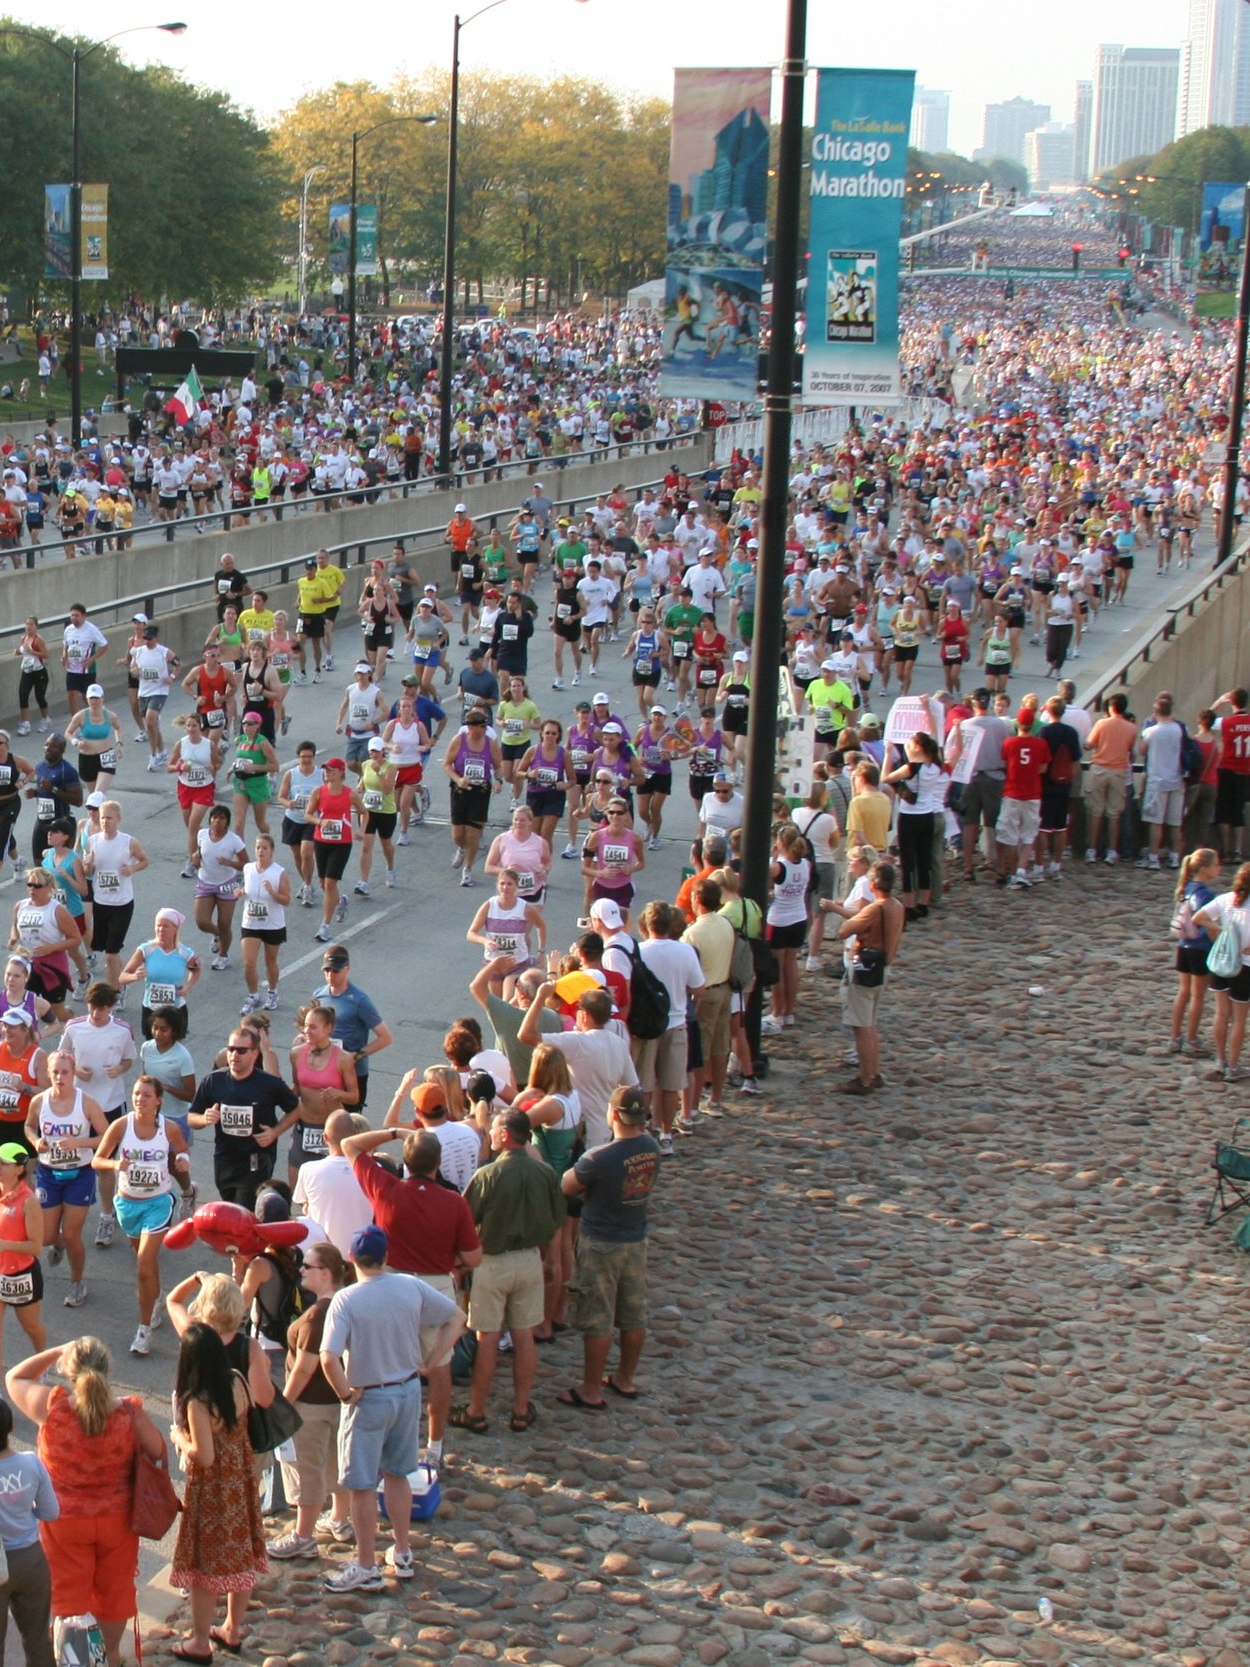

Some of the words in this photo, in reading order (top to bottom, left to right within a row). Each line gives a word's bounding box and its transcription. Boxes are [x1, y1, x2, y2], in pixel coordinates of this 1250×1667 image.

[811, 133, 891, 167] Chicago
[810, 169, 905, 198] Marathon
[810, 381, 852, 392] OCTOBER
[853, 383, 868, 394] 07,
[869, 383, 893, 393] 2007
[709, 410, 725, 421] TOP
[1233, 735, 1250, 758] 11
[1019, 747, 1031, 765] 5
[149, 987, 174, 1002] 25853
[221, 1112, 252, 1126] 35046
[128, 1169, 158, 1185] 19273
[0, 1280, 31, 1294] 36303
